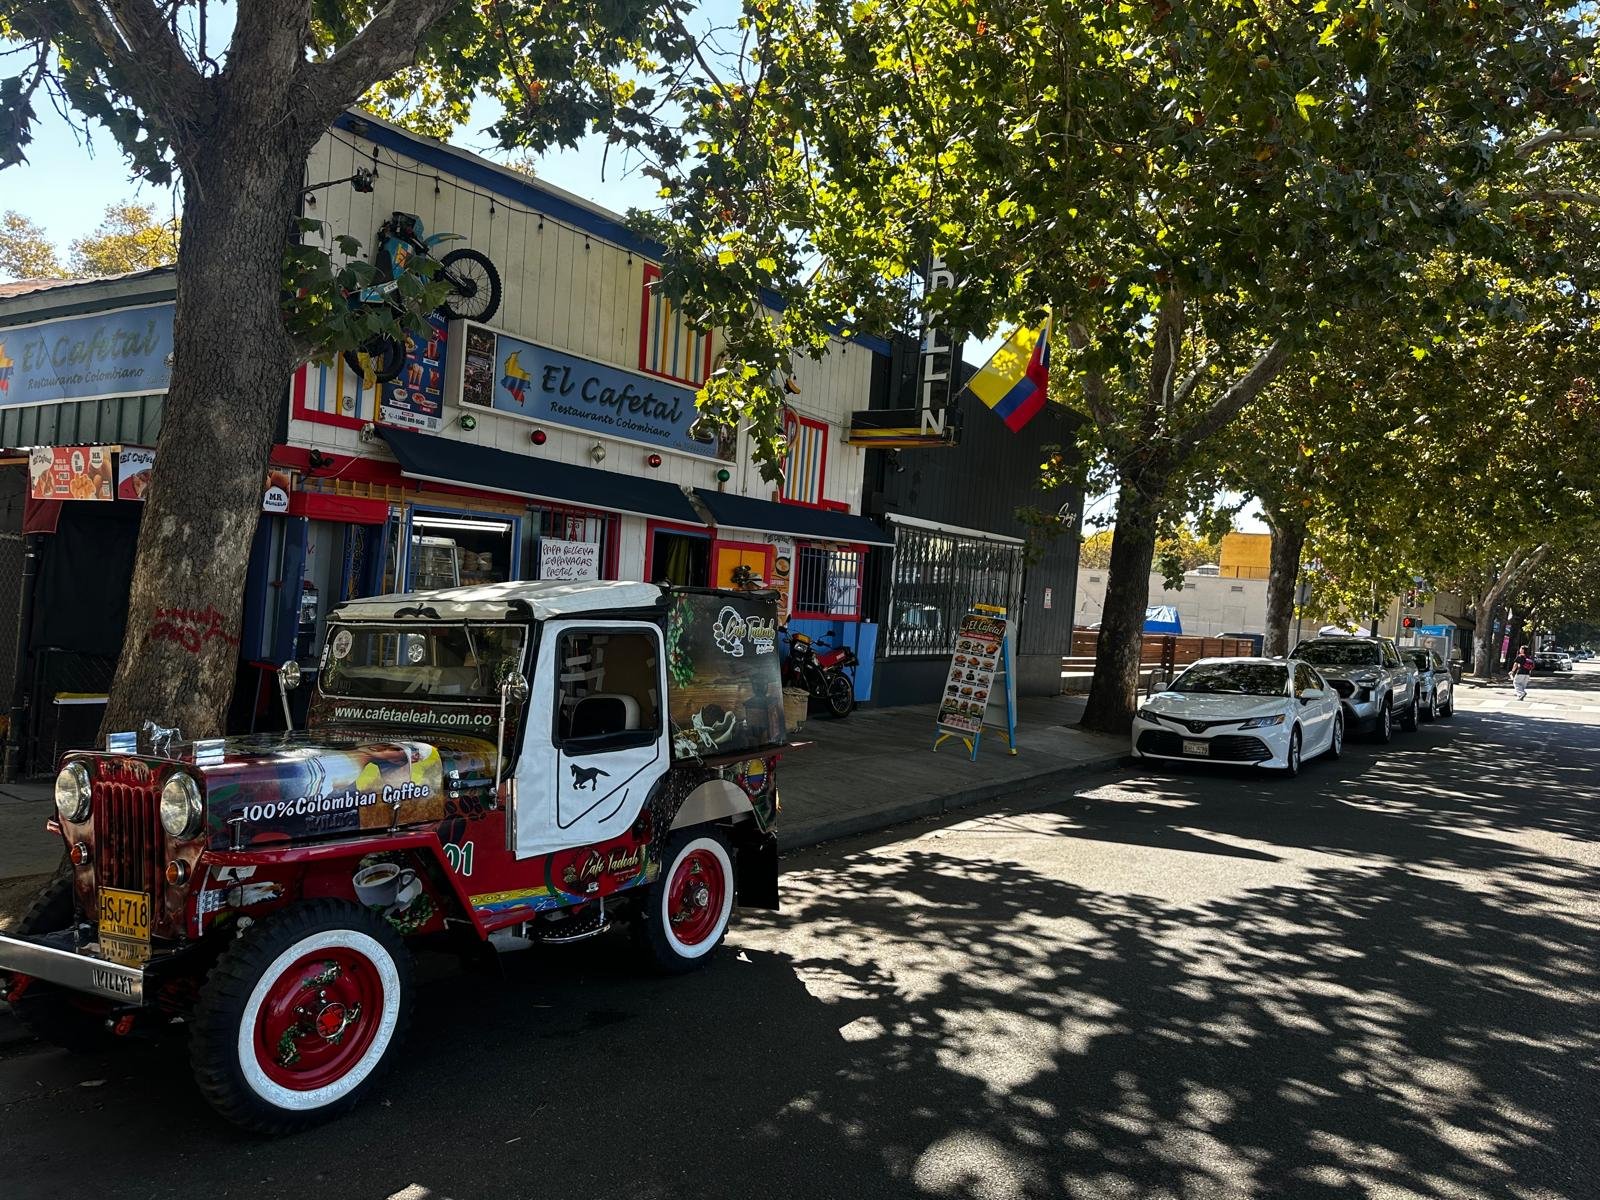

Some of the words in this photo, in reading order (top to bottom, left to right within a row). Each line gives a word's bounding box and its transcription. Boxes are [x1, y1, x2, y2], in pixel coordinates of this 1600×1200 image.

[52, 320, 160, 369] Cafetal
[85, 367, 145, 384] Colombiano
[542, 364, 576, 396] El
[581, 376, 684, 423] Cafetal
[550, 401, 614, 426] Restaurante
[616, 417, 671, 439] Colombiano
[269, 493, 282, 501] MR
[543, 544, 561, 555] PAPA
[545, 556, 593, 567] EMPANADAS
[547, 567, 573, 577] PASTEL
[335, 706, 492, 725] www.cafetaeleah.com.co
[382, 782, 430, 803] Coffee
